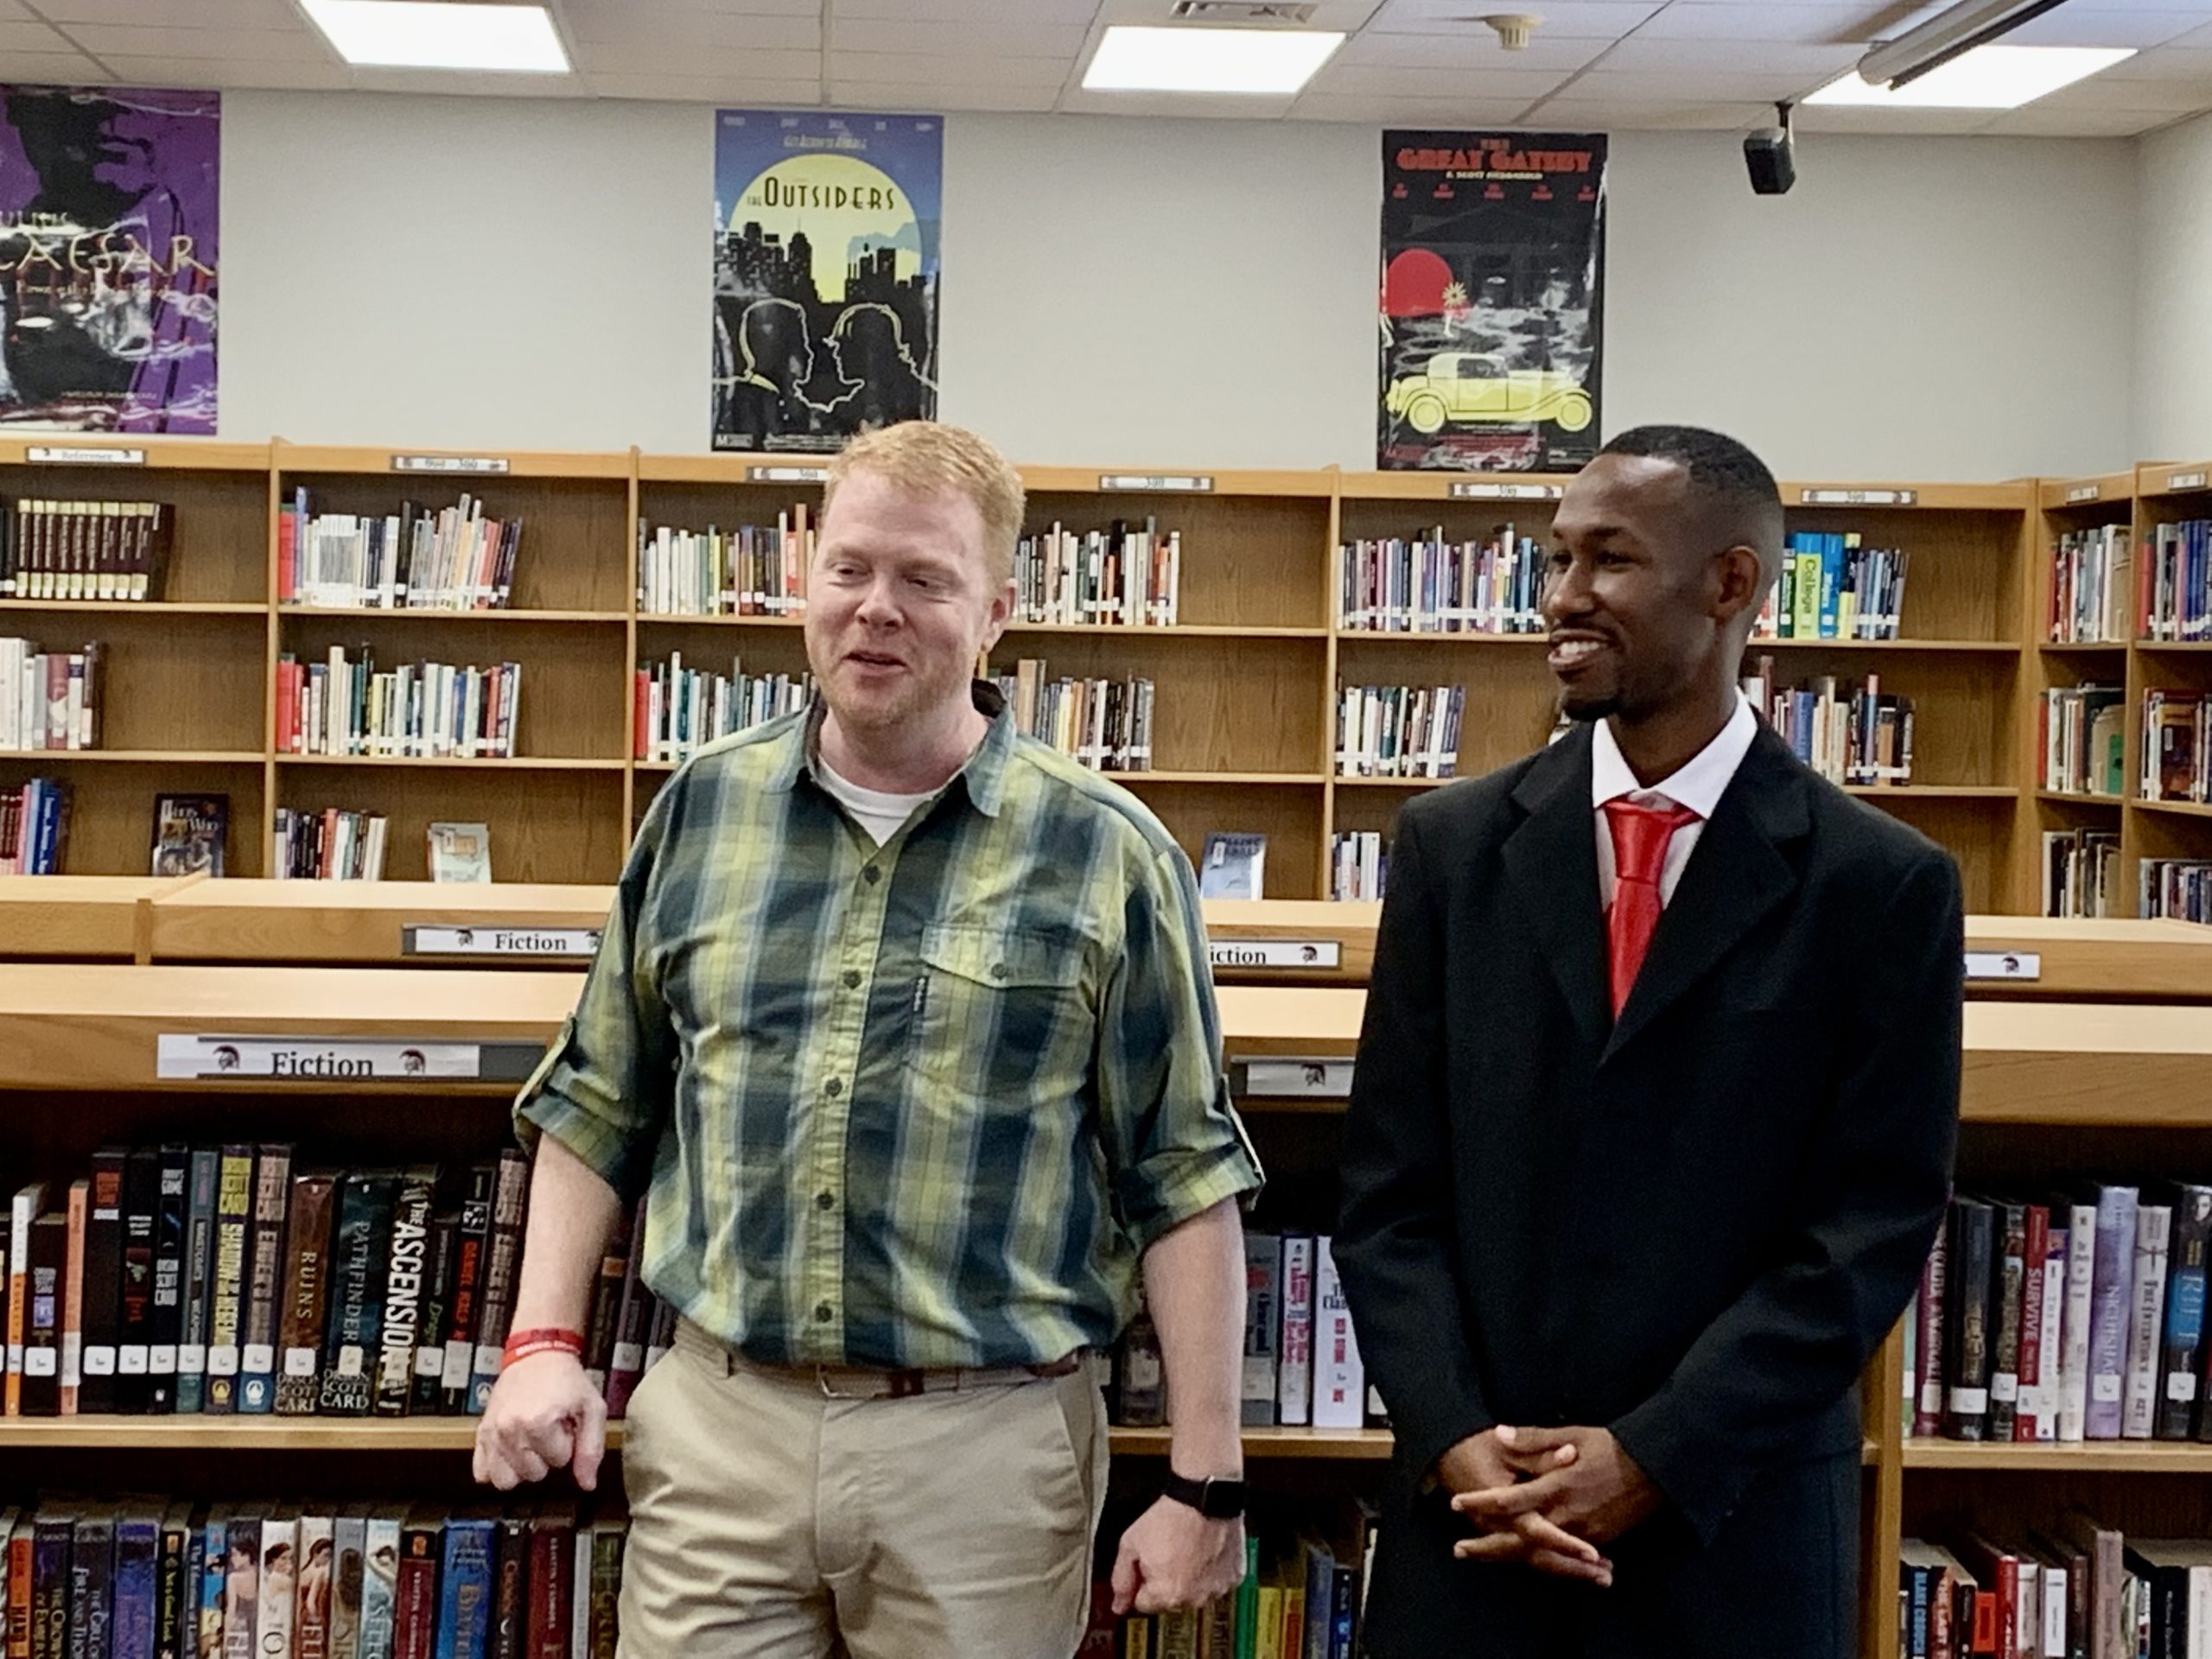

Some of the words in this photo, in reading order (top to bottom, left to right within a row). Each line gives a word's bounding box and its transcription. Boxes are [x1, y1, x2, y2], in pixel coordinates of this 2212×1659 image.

[1396, 148, 1484, 169] GREAT
[1489, 149, 1592, 171] GATSBY
[764, 176, 894, 210] OUTSIDERS
[494, 931, 567, 951] Fiction
[1210, 946, 1268, 965] iction
[270, 1052, 374, 1077] Fiction
[410, 1202, 430, 1225] THE
[296, 1251, 318, 1319] RUINS
[342, 1220, 372, 1343] PATHFINDER
[380, 1220, 427, 1363] ASCENSION
[2024, 1268, 2042, 1341] SURVIVE
[2177, 1275, 2204, 1344] RIFT
[322, 1379, 369, 1395] SCOTT
[320, 1393, 370, 1410] CARD
[190, 1544, 203, 1563] The
[72, 1566, 90, 1596] FIRE
[50, 1588, 65, 1608] THE
[91, 1590, 102, 1608] THE
[74, 1600, 85, 1624] AND
[89, 1611, 109, 1644] GIRL
[1936, 1608, 1948, 1644] LAST
